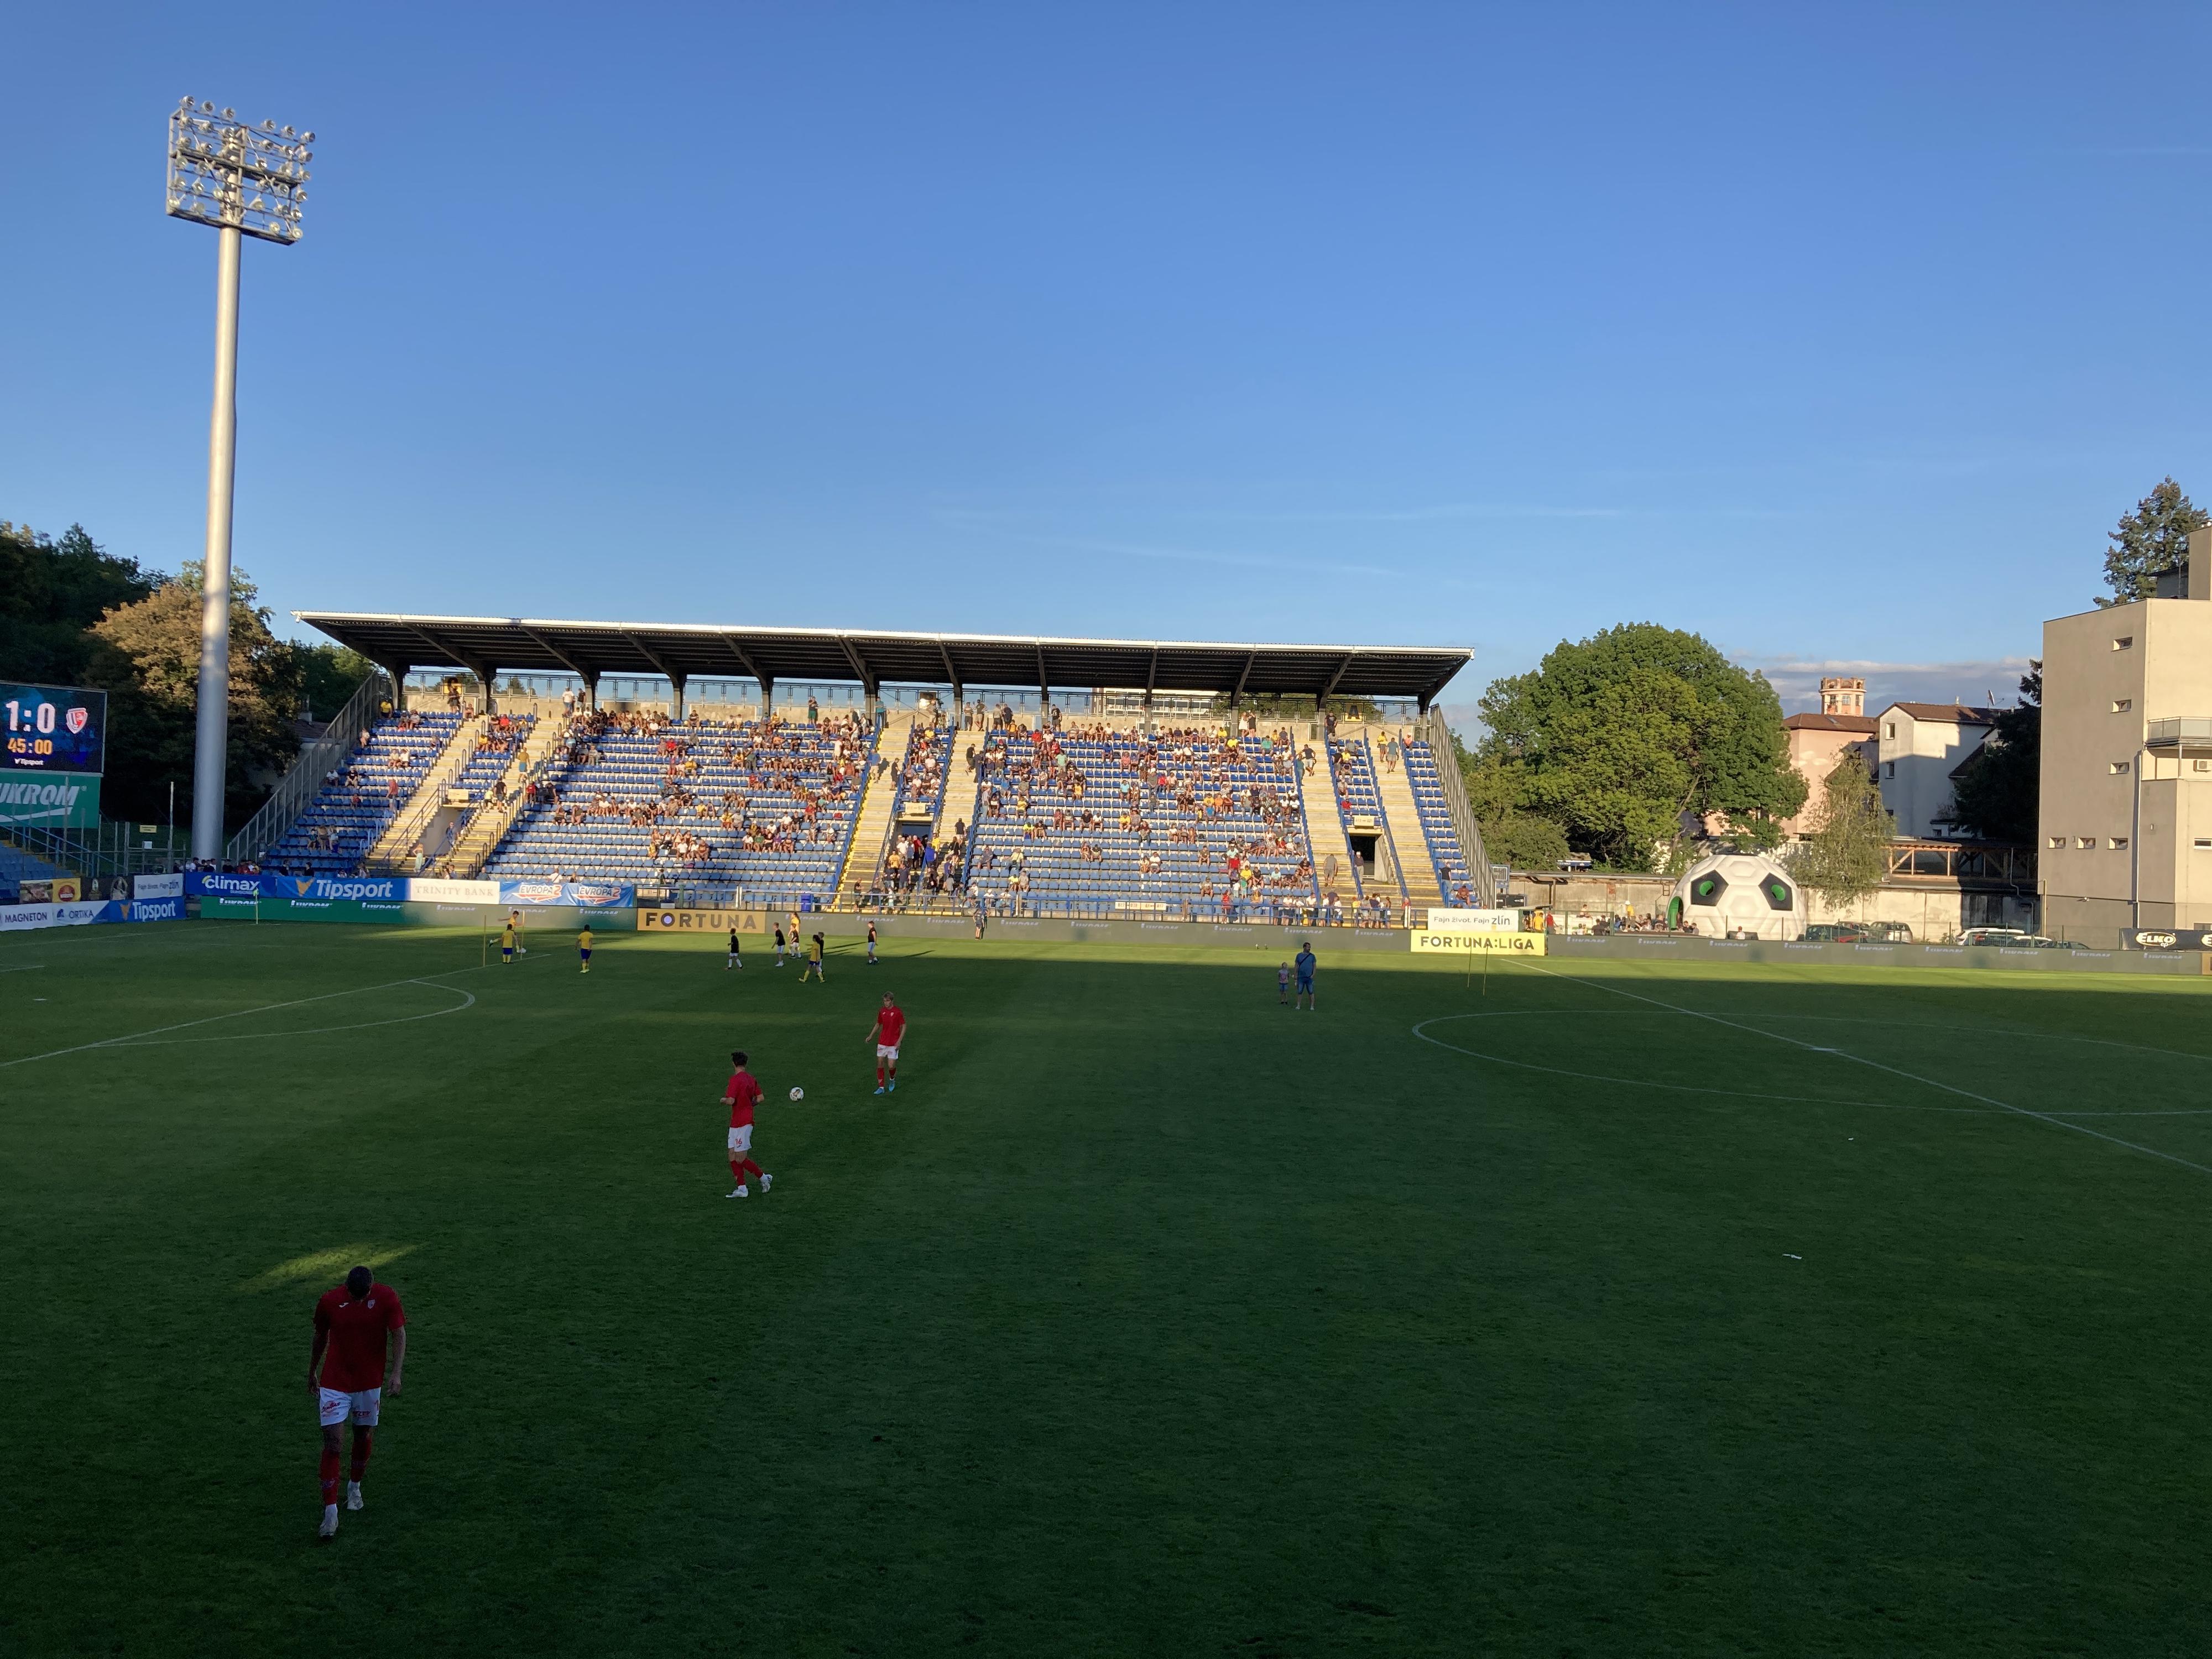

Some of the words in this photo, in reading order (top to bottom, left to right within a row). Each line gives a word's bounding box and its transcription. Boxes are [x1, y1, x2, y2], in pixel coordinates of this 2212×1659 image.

[6, 701, 55, 733] 1:0
[1347, 705, 1360, 719] A
[7, 737, 53, 755] 45:00
[202, 875, 260, 891] climax
[317, 879, 393, 900] Tipsport
[416, 886, 461, 895] TRINITY
[465, 888, 494, 896] BANK
[4, 912, 48, 923] MAGNETON
[69, 910, 94, 919] ORTIKA
[132, 900, 176, 922] Tipsport
[645, 912, 757, 930] FORTUNA
[1491, 915, 1510, 926] zlín
[2138, 932, 2175, 943] ELKO
